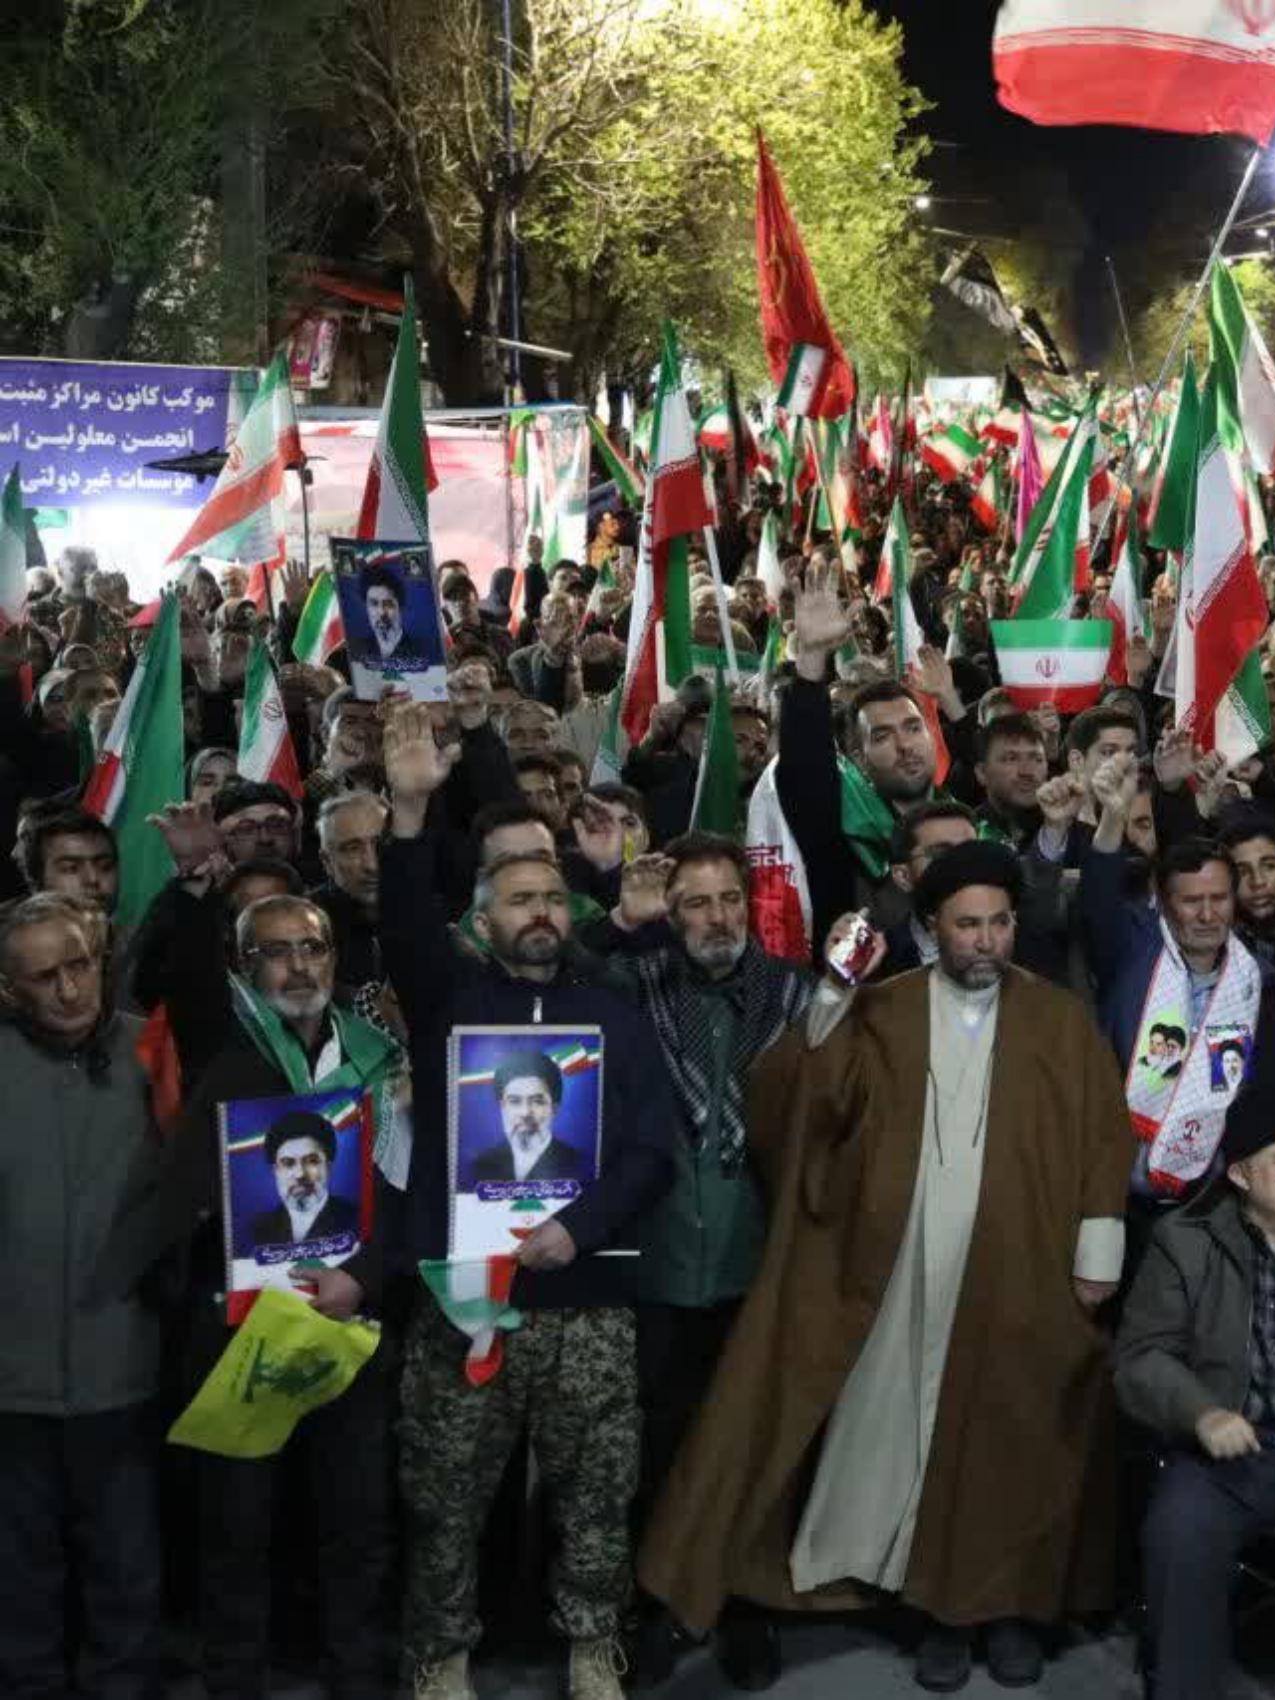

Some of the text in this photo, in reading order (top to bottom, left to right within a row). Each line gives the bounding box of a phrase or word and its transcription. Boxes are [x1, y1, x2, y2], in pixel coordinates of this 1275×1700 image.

[49, 381, 102, 410] مراکز
[107, 384, 160, 411] کانون
[162, 386, 215, 414] موکب
[25, 422, 116, 452] معلولین
[120, 427, 194, 453] انجمن
